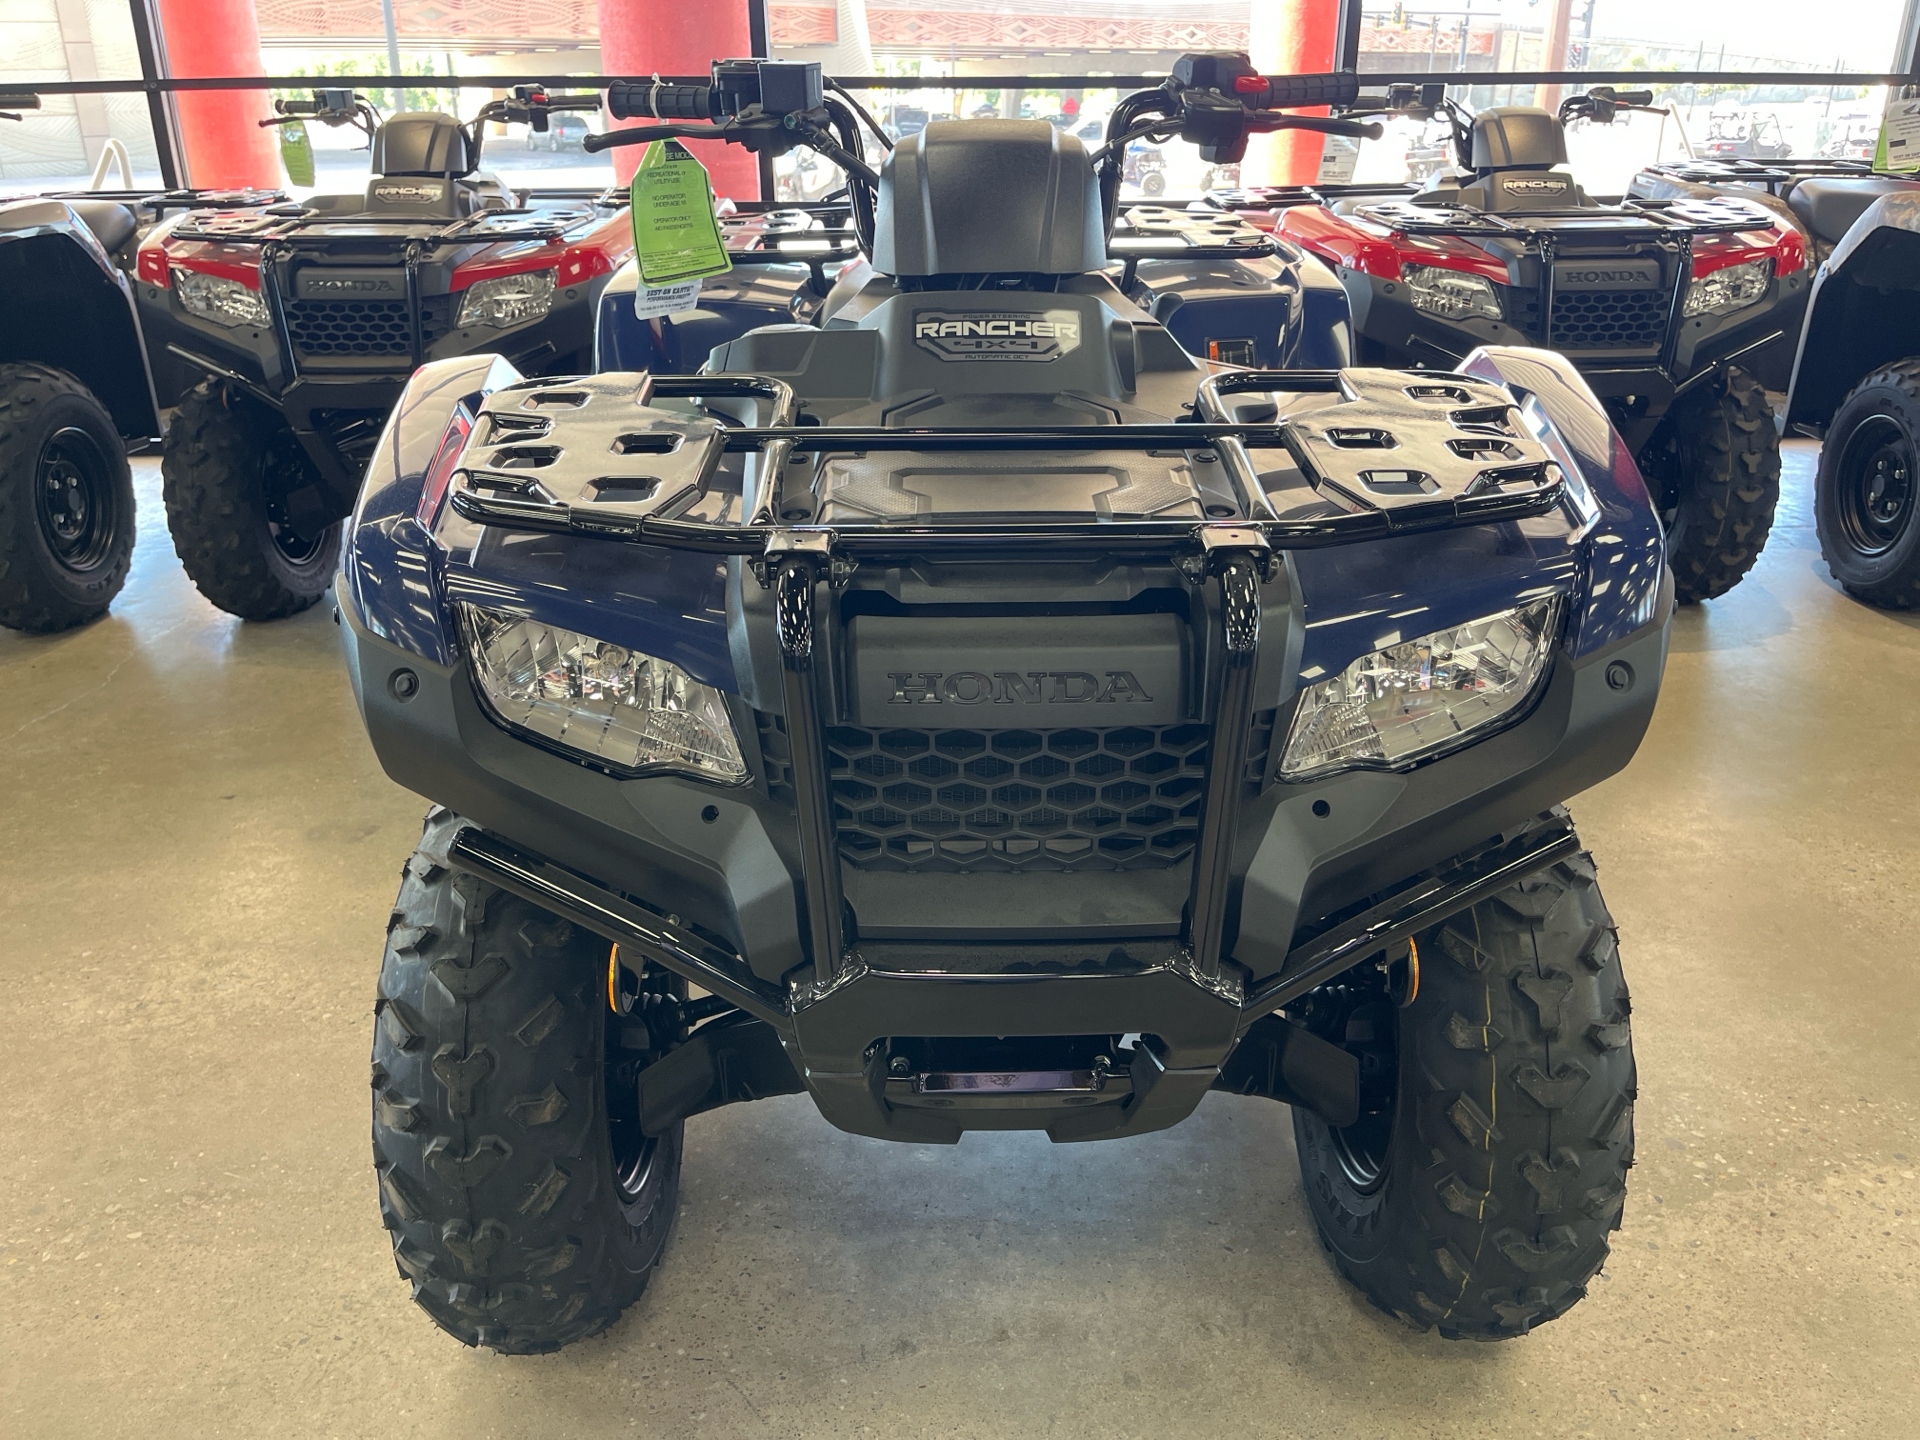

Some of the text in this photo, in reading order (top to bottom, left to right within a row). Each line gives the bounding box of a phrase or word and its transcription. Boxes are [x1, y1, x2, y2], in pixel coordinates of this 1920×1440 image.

[646, 170, 681, 178] RECREATIONAL
[375, 187, 442, 197] RANCHER
[1503, 181, 1568, 190] RANCHER
[1564, 271, 1652, 284] HONDA
[306, 280, 395, 293] HONDA
[916, 321, 1077, 338] RANCHER
[887, 671, 1154, 705] HONDA
